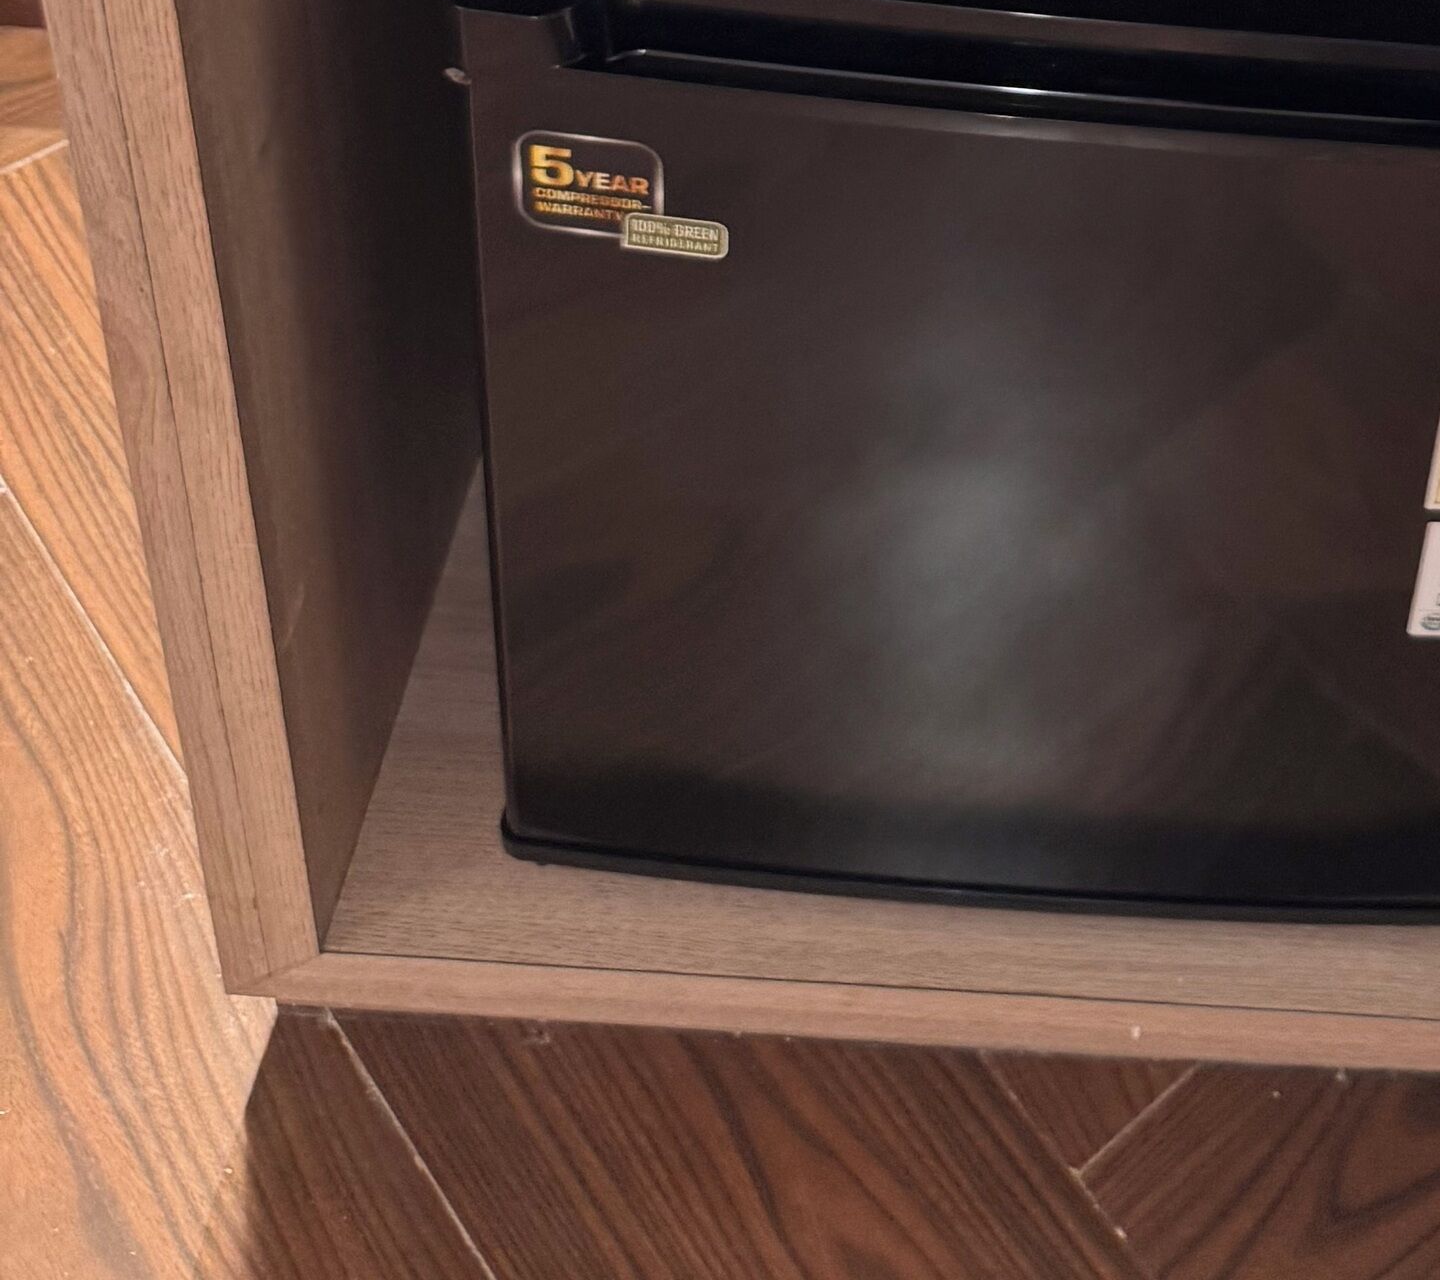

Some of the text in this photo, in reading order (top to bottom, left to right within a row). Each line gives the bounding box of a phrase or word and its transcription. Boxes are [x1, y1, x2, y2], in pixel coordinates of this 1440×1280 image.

[529, 144, 650, 195] 5 YEAR
[533, 187, 643, 210] COMPRESSOR
[533, 201, 625, 221] WARRANTY
[631, 217, 719, 241] 100% GREEN
[630, 232, 719, 252] REFRIGERANT
